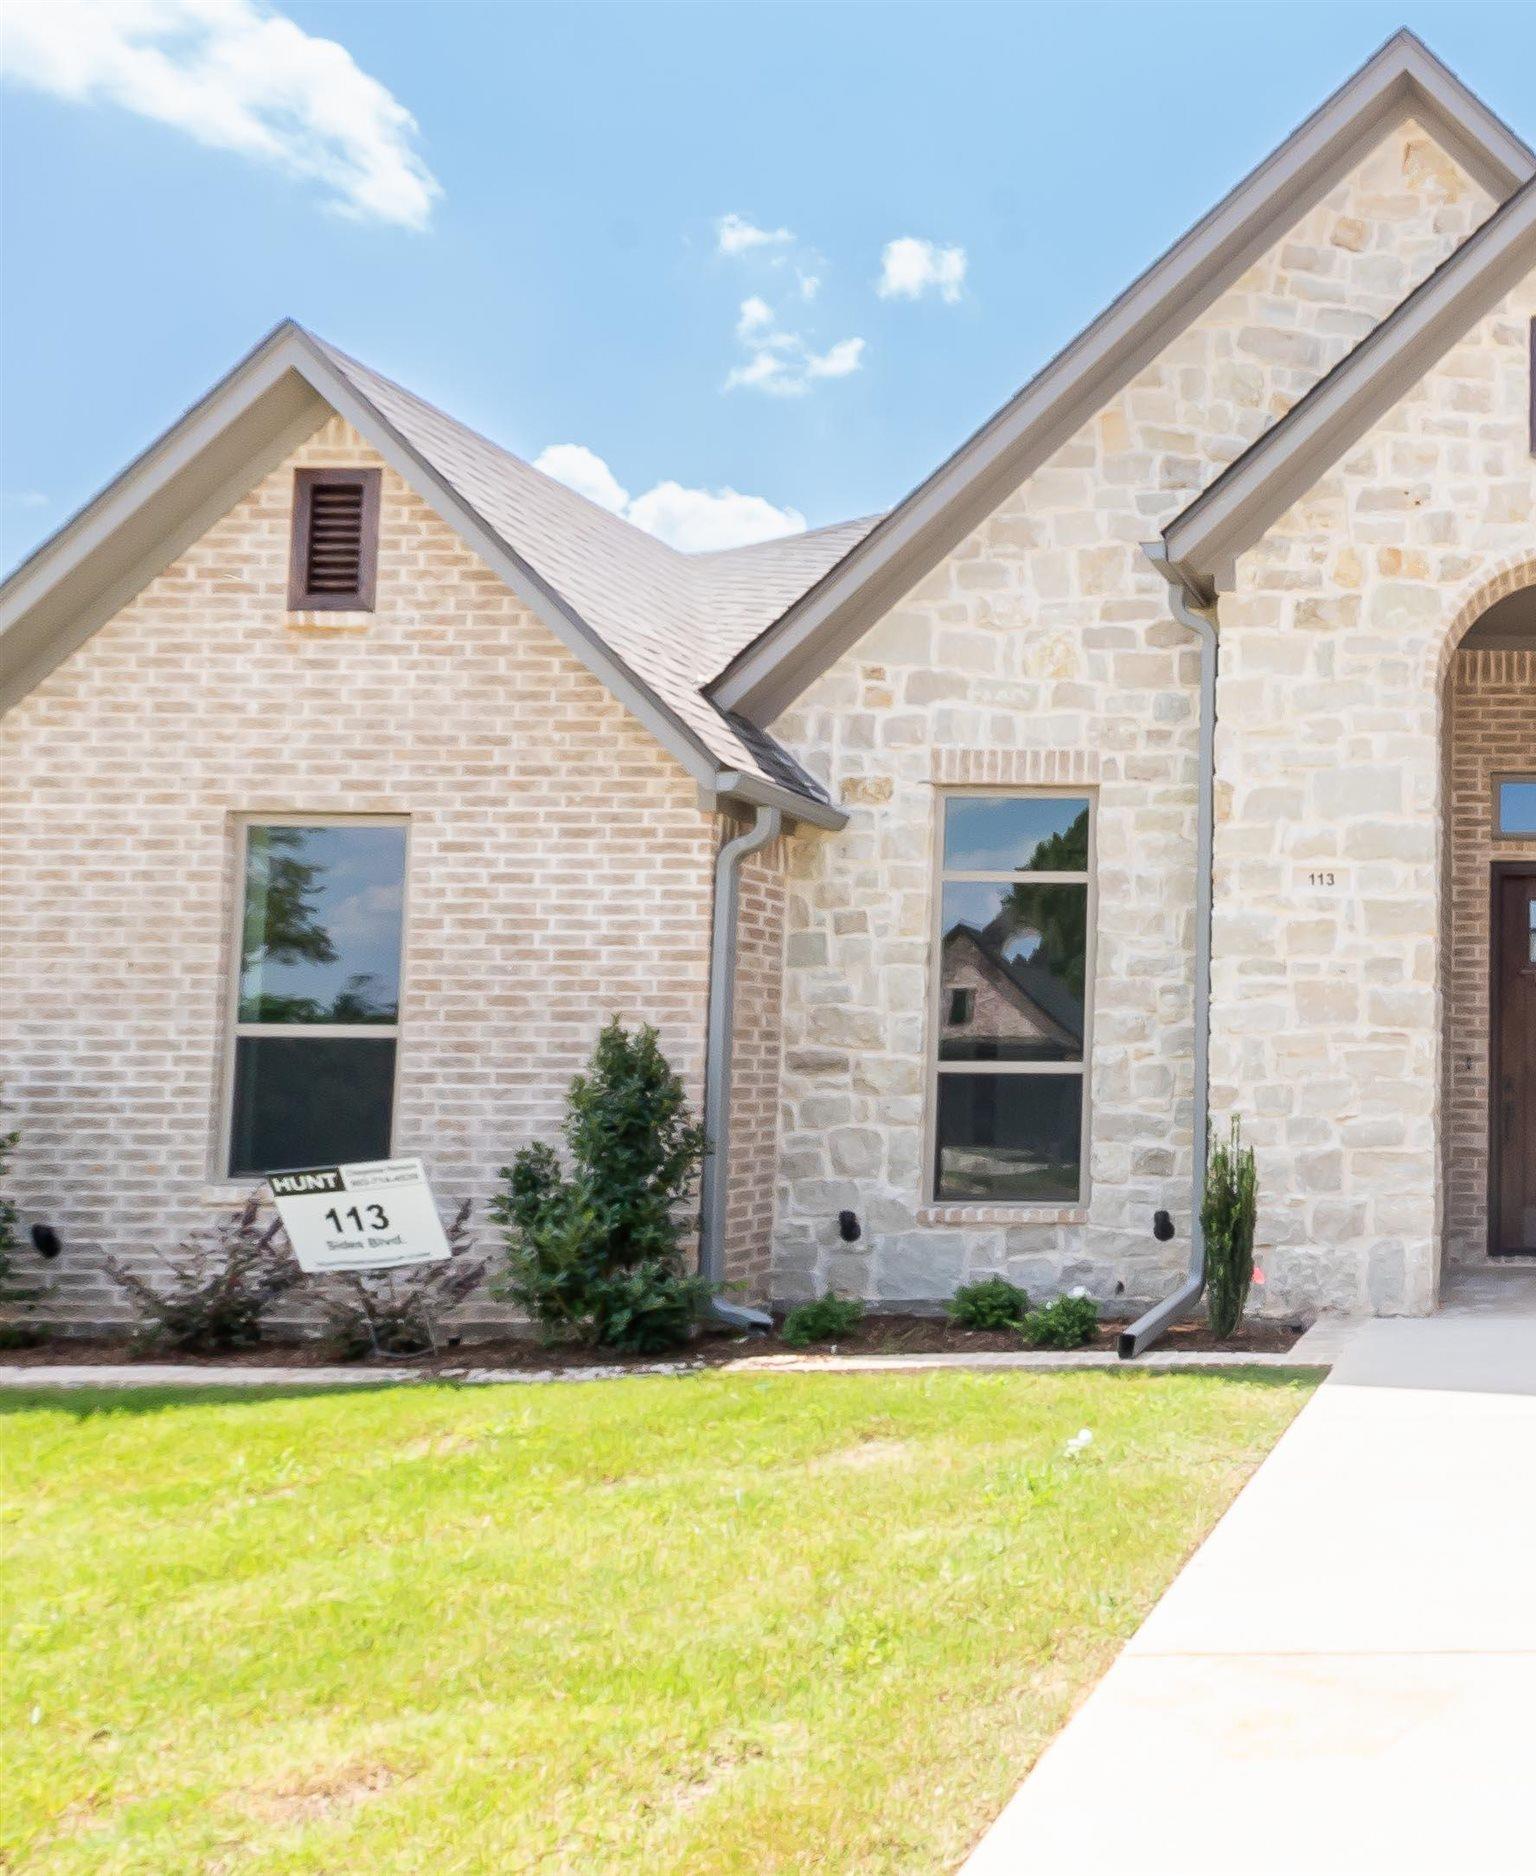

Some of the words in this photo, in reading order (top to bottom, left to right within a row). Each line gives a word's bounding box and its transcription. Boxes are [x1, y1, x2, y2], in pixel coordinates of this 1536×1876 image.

[1309, 872, 1335, 886] 113
[271, 1173, 338, 1193] HUNT
[325, 1204, 390, 1233] 113
